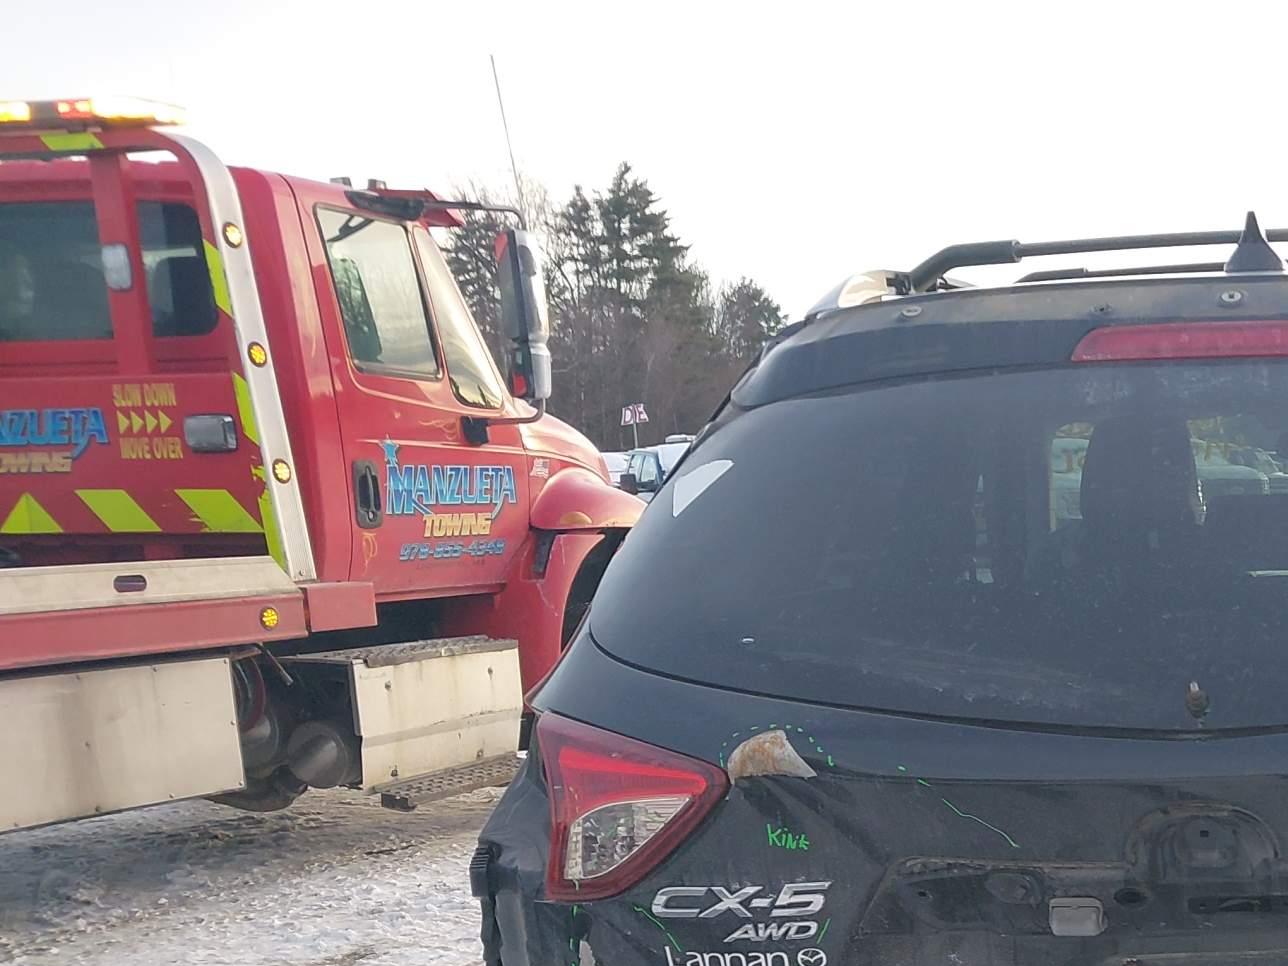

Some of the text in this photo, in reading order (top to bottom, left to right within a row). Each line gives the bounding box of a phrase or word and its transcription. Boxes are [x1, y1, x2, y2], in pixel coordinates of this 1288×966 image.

[112, 382, 176, 407] SLOW DOWN
[120, 437, 183, 459] MOVE OVER
[385, 464, 517, 519] MANZUETA
[423, 513, 493, 537] TOWING
[651, 880, 832, 918] CX-5
[723, 920, 820, 943] AWD
